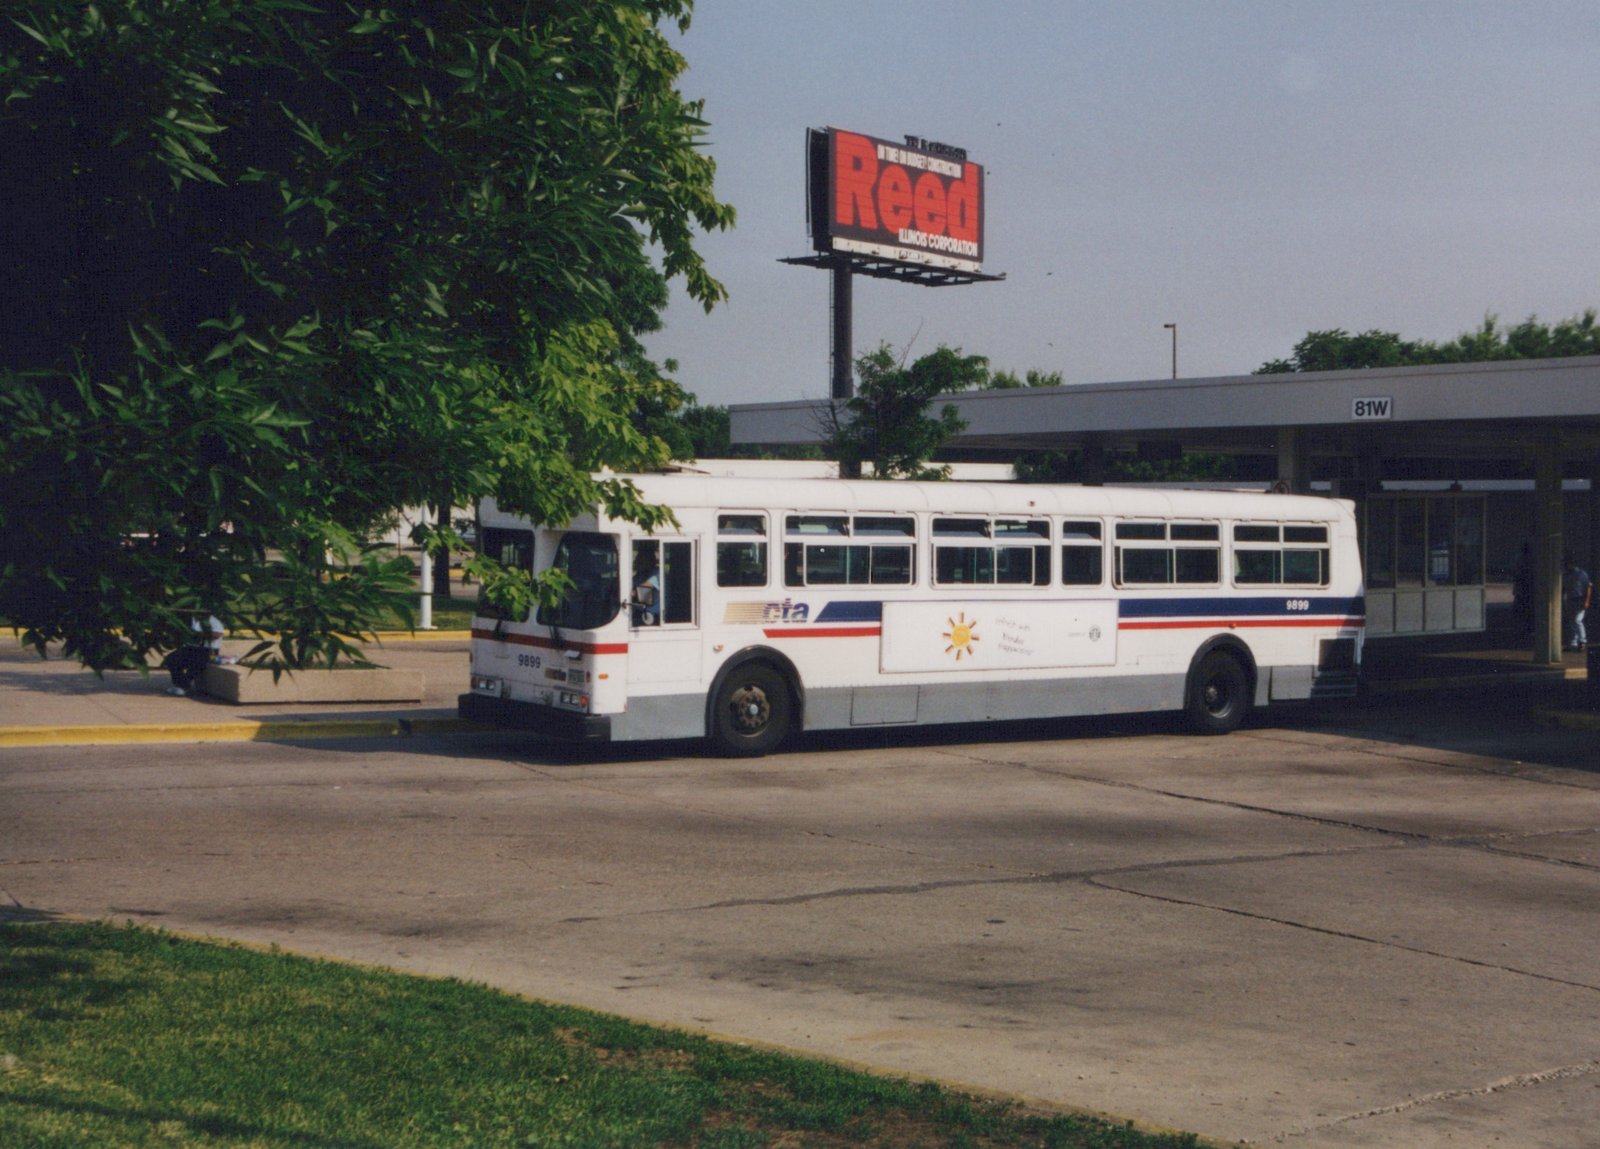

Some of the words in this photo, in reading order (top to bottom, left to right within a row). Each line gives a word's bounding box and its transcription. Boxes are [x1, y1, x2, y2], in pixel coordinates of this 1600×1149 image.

[835, 131, 978, 243] Reed
[898, 228, 928, 248] ILLINOIS
[928, 233, 978, 257] CORPORATION
[1355, 400, 1389, 417] 81W
[762, 598, 810, 624] cta
[1286, 599, 1310, 611] 9899
[518, 653, 541, 669] 9899
